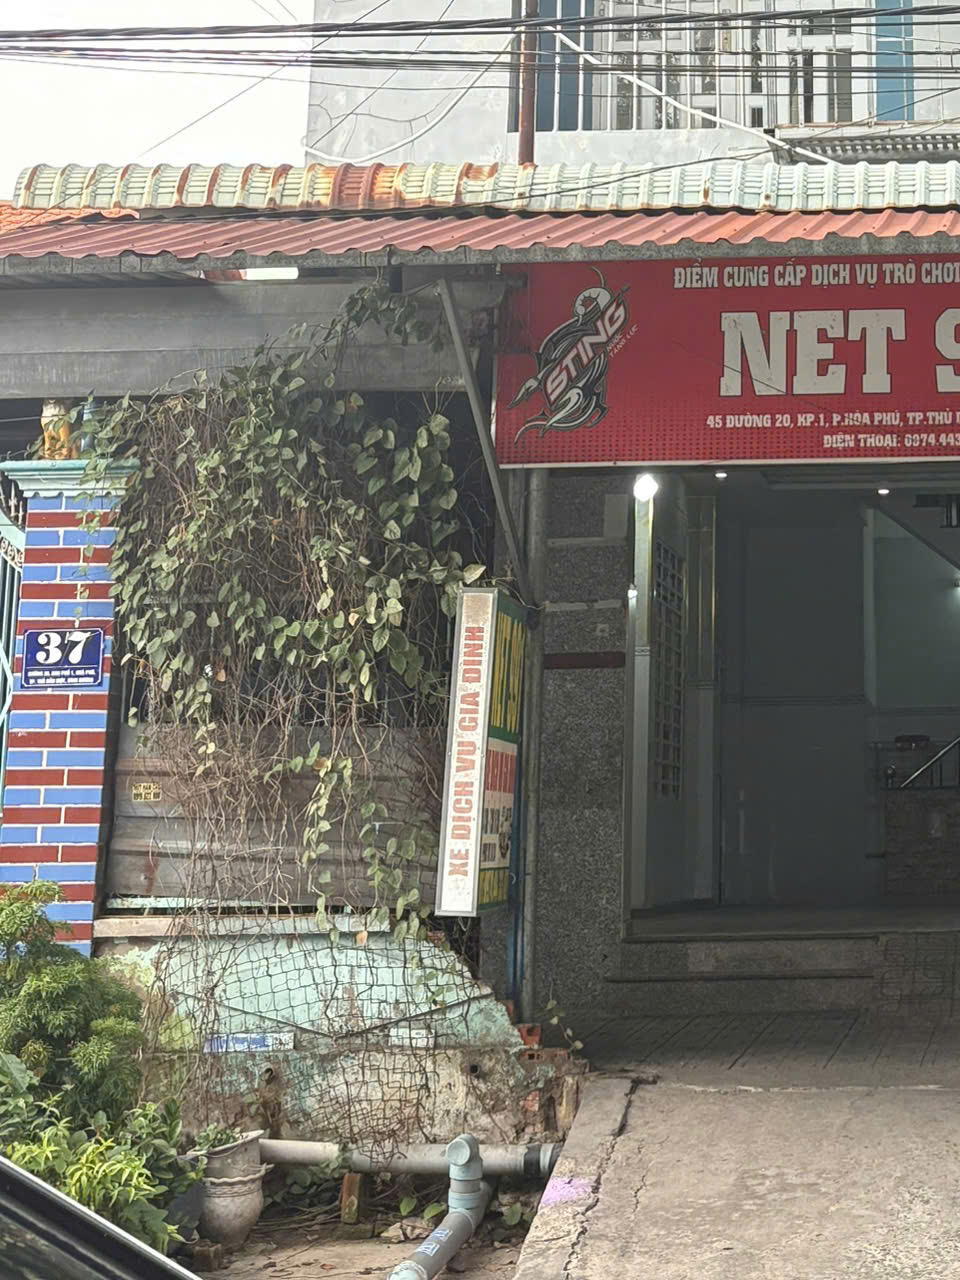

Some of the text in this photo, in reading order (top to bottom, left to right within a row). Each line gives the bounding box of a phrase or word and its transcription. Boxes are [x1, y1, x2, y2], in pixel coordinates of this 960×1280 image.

[673, 258, 719, 289] ĐIỂM
[723, 266, 769, 288] CUNG
[774, 258, 807, 288] CẤP
[811, 263, 850, 289] DỊCH
[855, 263, 878, 289] VỤ
[882, 259, 916, 284] TRÒ
[921, 262, 960, 284] CHƠI
[546, 302, 625, 403] STING
[719, 309, 907, 397] NET
[706, 414, 722, 428] 45
[775, 414, 795, 429] 20,
[35, 631, 91, 665] 37
[448, 848, 470, 877] XE
[459, 691, 481, 732] GIA
